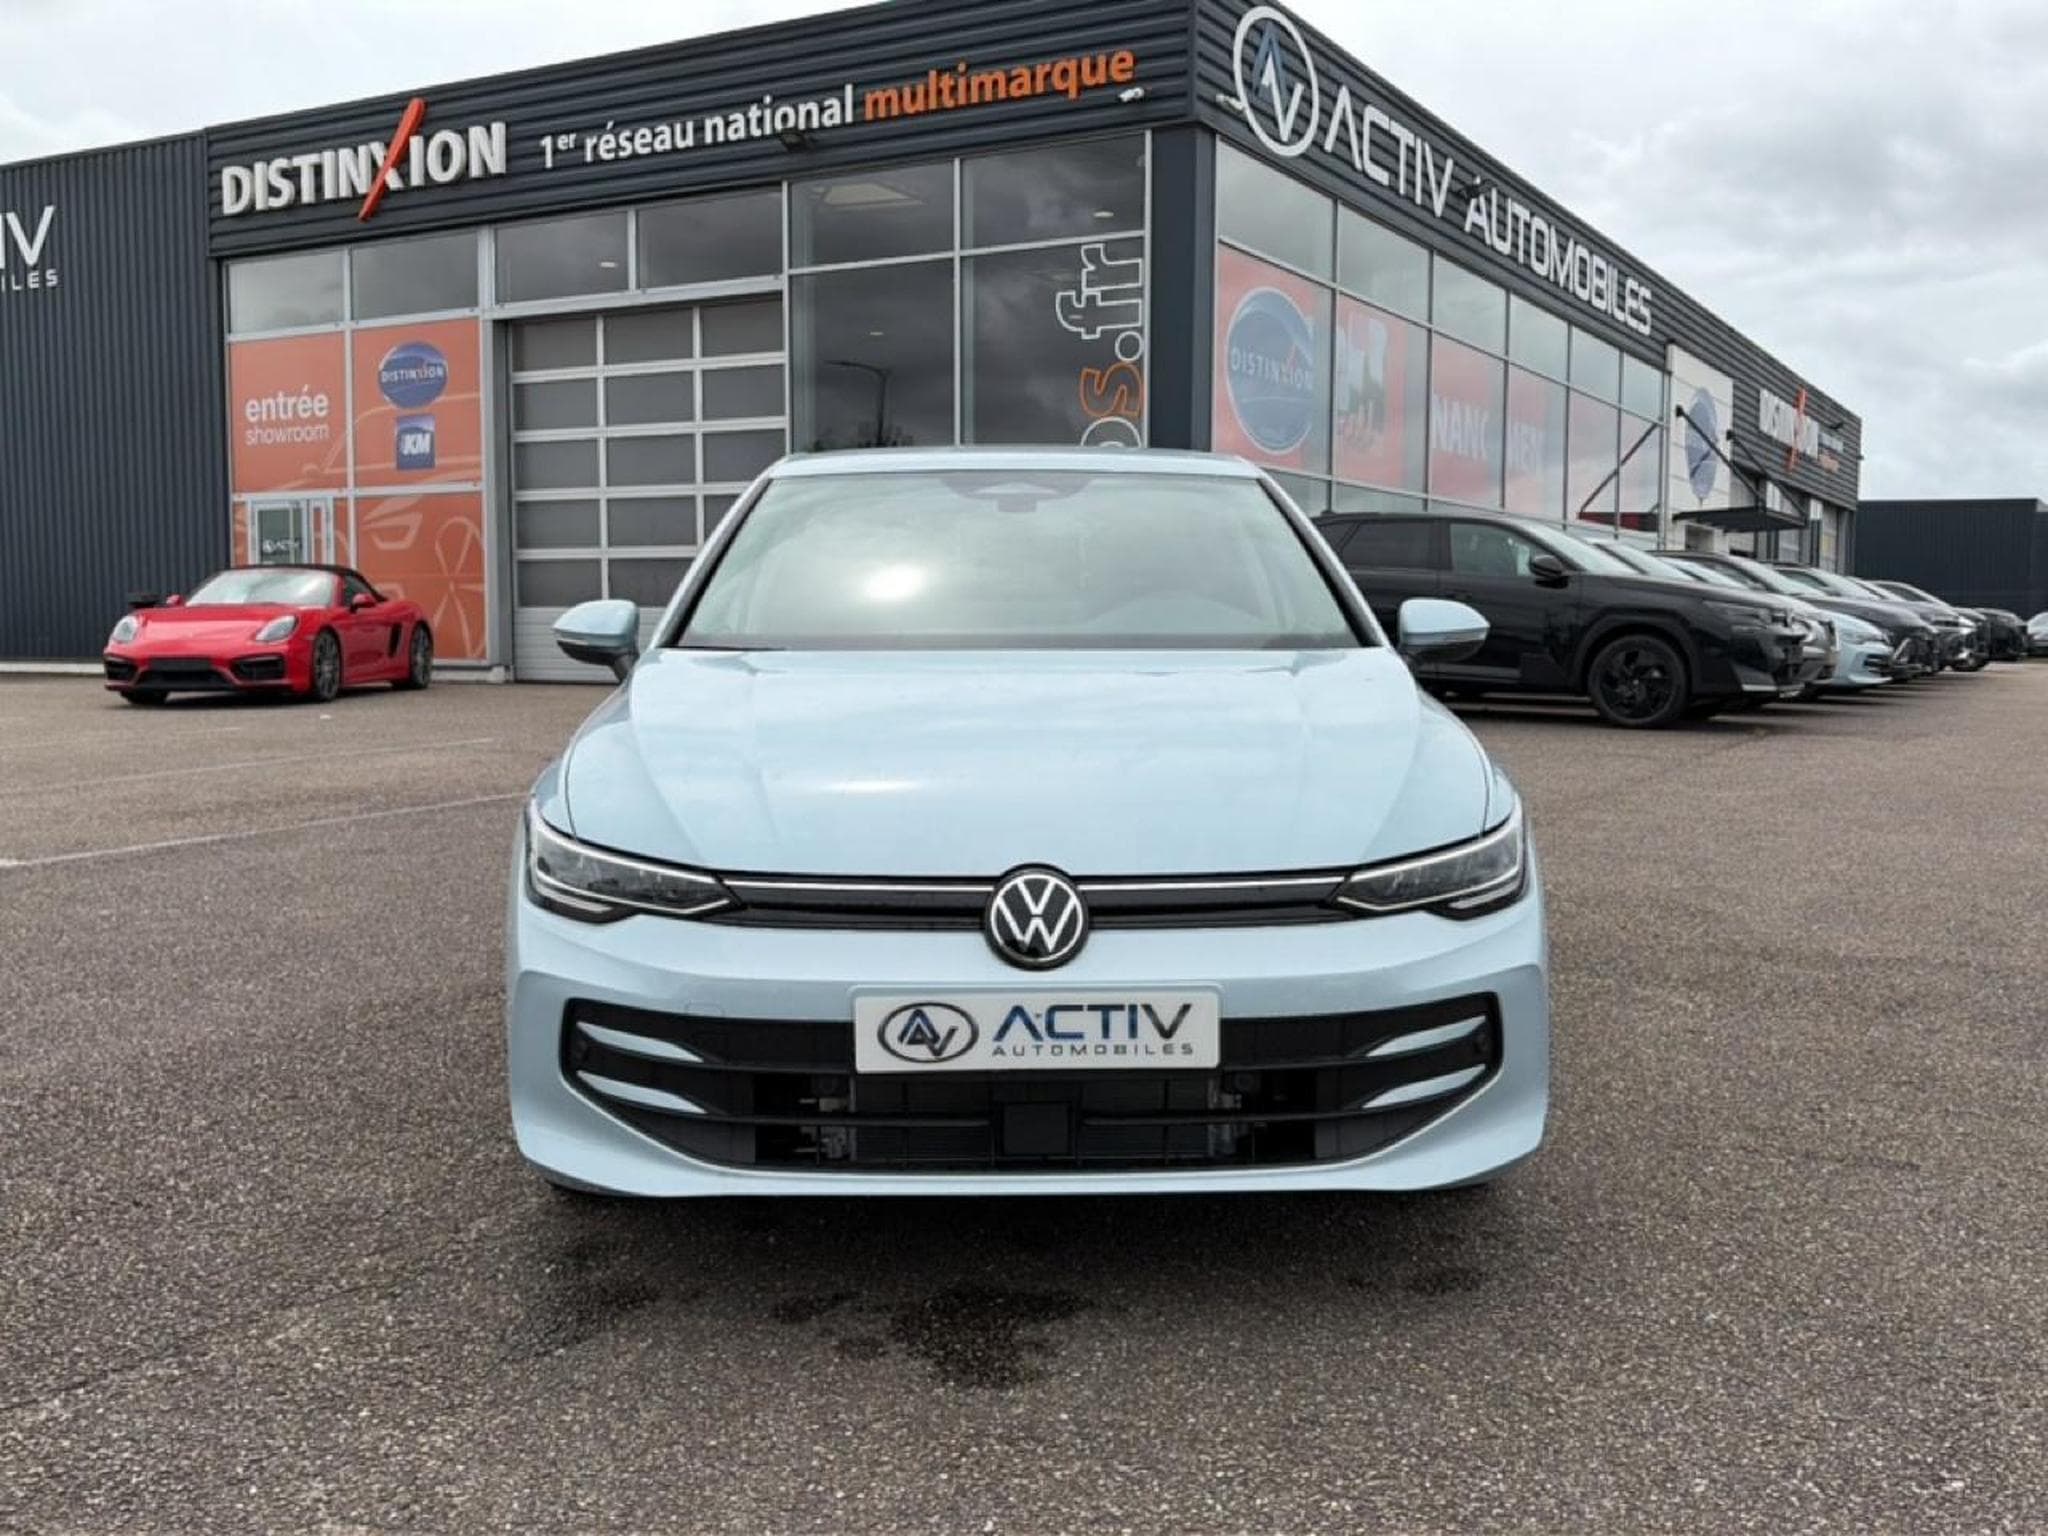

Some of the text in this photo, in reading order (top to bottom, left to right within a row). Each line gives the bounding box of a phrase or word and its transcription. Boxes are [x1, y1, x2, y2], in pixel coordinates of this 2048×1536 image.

[584, 121, 695, 163] réseau
[703, 84, 854, 145] national
[864, 49, 1135, 122] multimarque
[221, 97, 507, 222] DISTINXION
[1324, 84, 1453, 218] ACTIV
[1464, 174, 1652, 336] AUTOMOBILES
[245, 384, 329, 422] entrée
[245, 423, 329, 446] showroom
[992, 1002, 1193, 1043] ACTIV
[991, 1042, 1194, 1058] AUTOMOBILES
